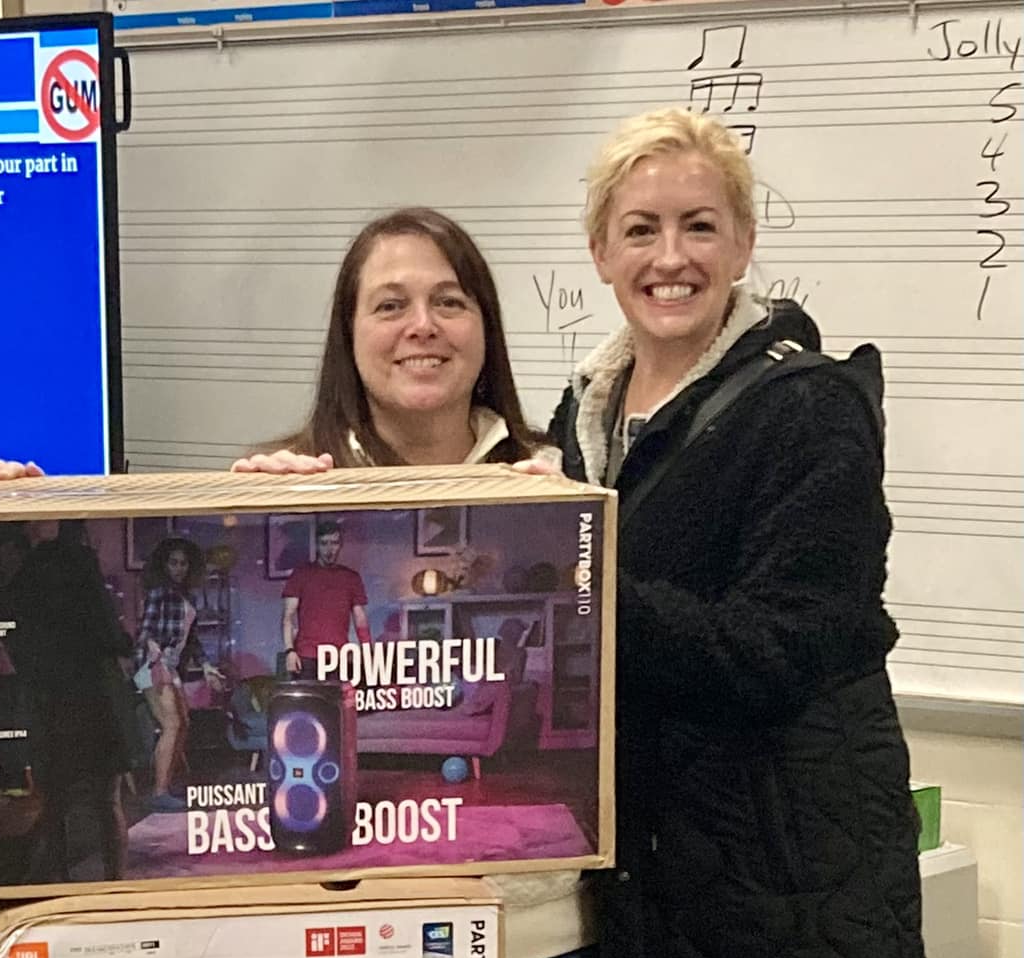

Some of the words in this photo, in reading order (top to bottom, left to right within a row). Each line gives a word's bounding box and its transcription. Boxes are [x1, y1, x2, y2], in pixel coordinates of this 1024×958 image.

[928, 18, 1021, 71] Jolly
[50, 80, 97, 114] GUM
[989, 83, 1022, 124] 5
[25, 154, 58, 178] part
[60, 152, 78, 172] in
[981, 132, 1009, 172] 4
[976, 181, 1010, 218] 3
[977, 229, 1008, 268] 2
[533, 269, 584, 333] You
[578, 512, 594, 616] PARTYBOX110
[316, 637, 506, 687] POWERFUL
[355, 687, 397, 712] BASS
[400, 685, 455, 710] BOOST
[186, 783, 267, 808] PUISSANT
[187, 806, 276, 856] BASS
[352, 797, 463, 846] BOOST
